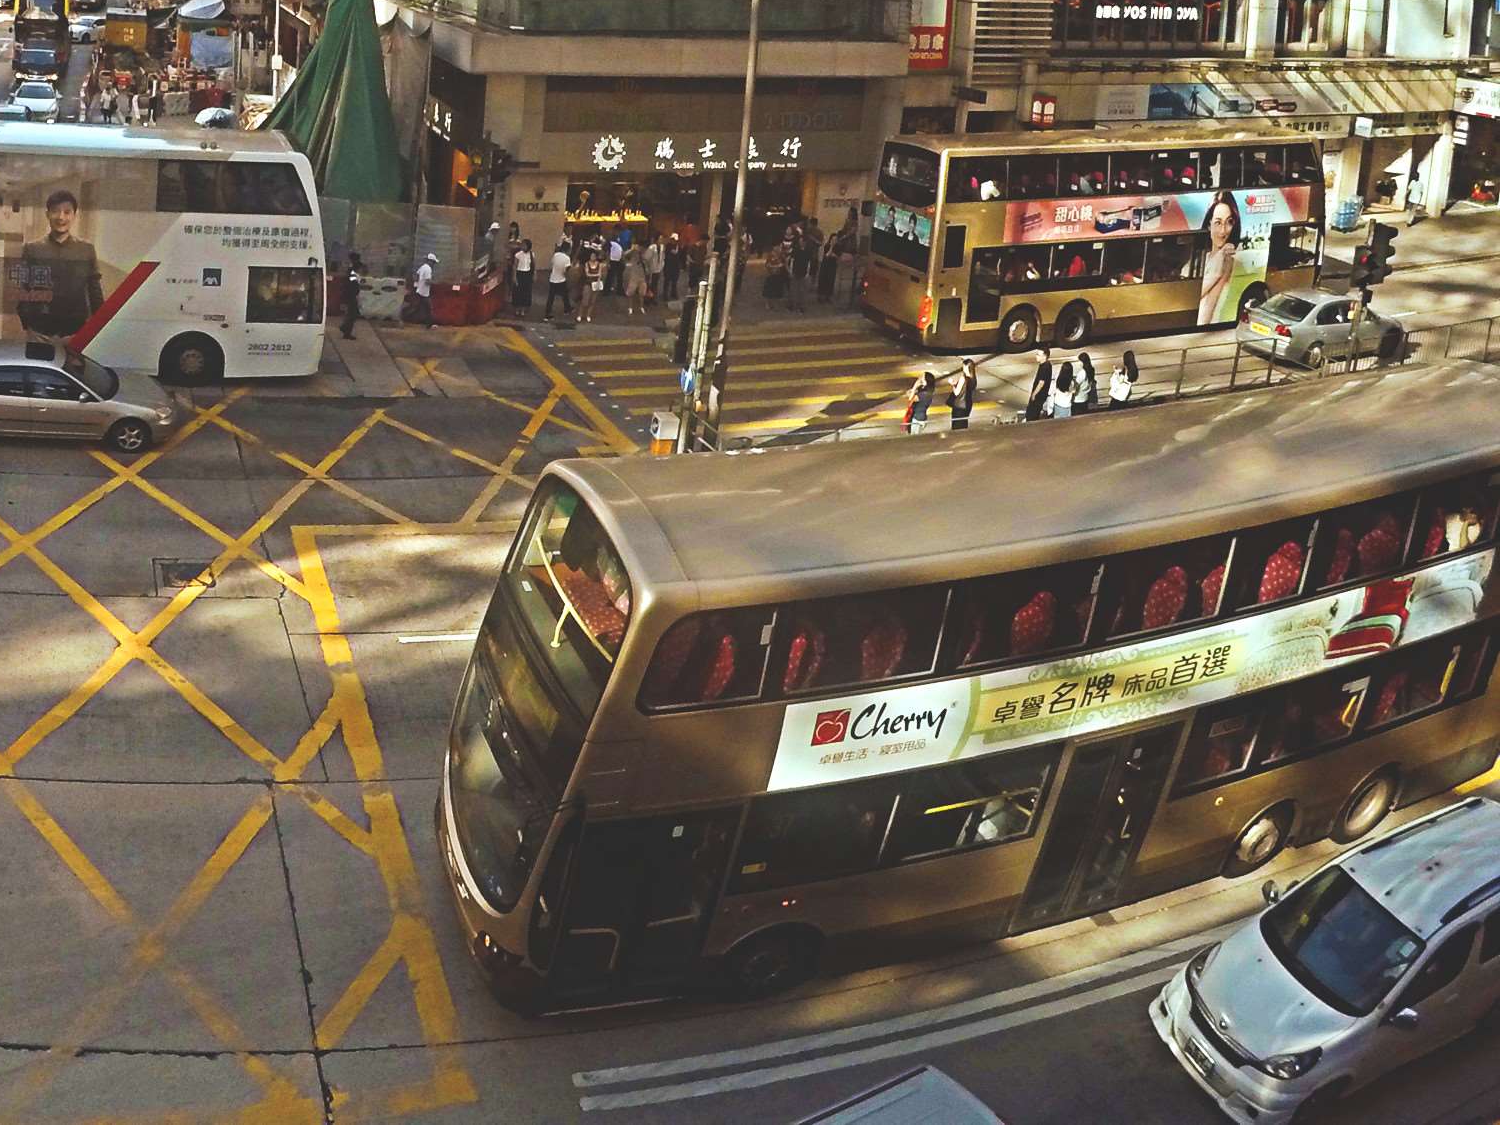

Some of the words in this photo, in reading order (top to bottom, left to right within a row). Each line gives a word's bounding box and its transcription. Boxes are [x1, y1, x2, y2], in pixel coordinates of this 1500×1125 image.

[703, 160, 726, 170] Watch
[734, 161, 767, 171] Cpany
[517, 203, 559, 212] ROLEX
[850, 702, 947, 740] Cherry
